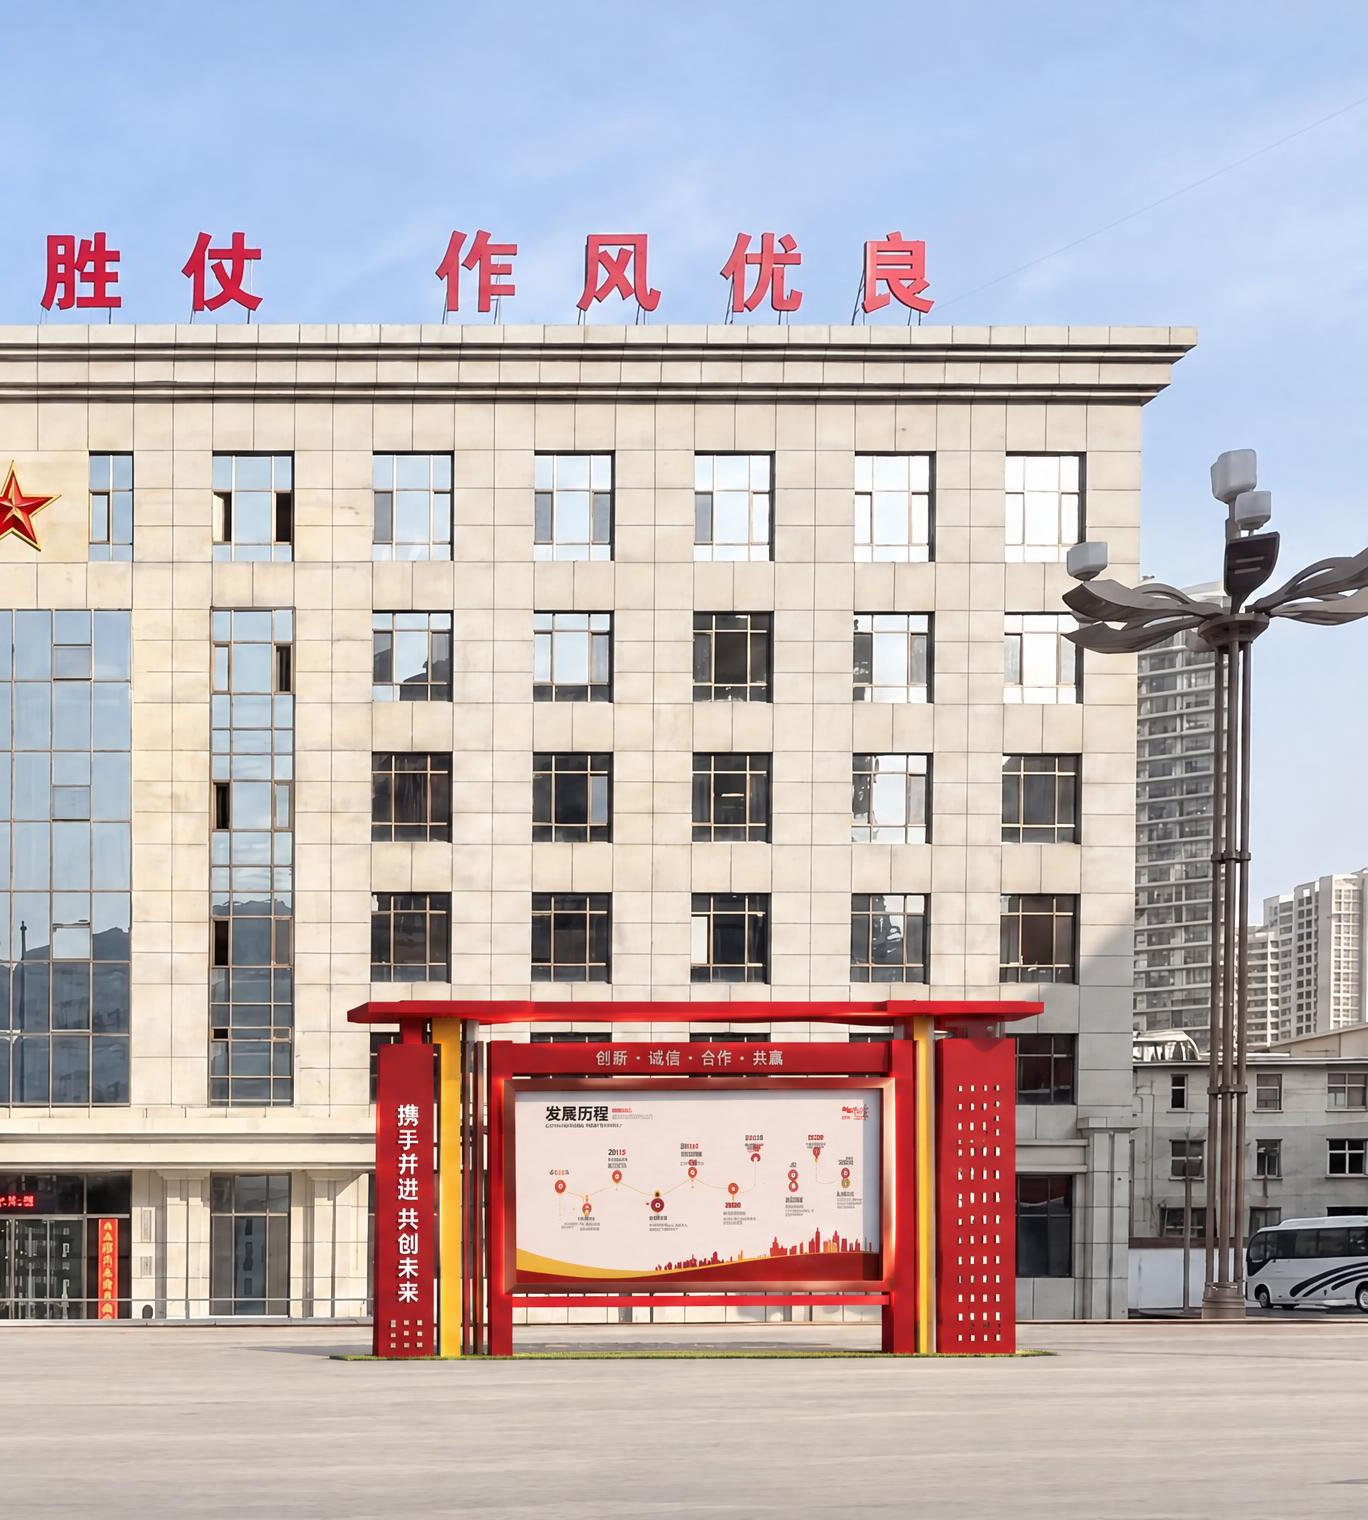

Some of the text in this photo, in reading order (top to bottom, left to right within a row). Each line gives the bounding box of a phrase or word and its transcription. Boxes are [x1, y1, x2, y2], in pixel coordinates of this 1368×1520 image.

[435, 230, 935, 313] 作风优良
[701, 1050, 732, 1067] 合作
[545, 1105, 609, 1122] 发展历程
[397, 1104, 419, 1303] 携手并进 共创未来
